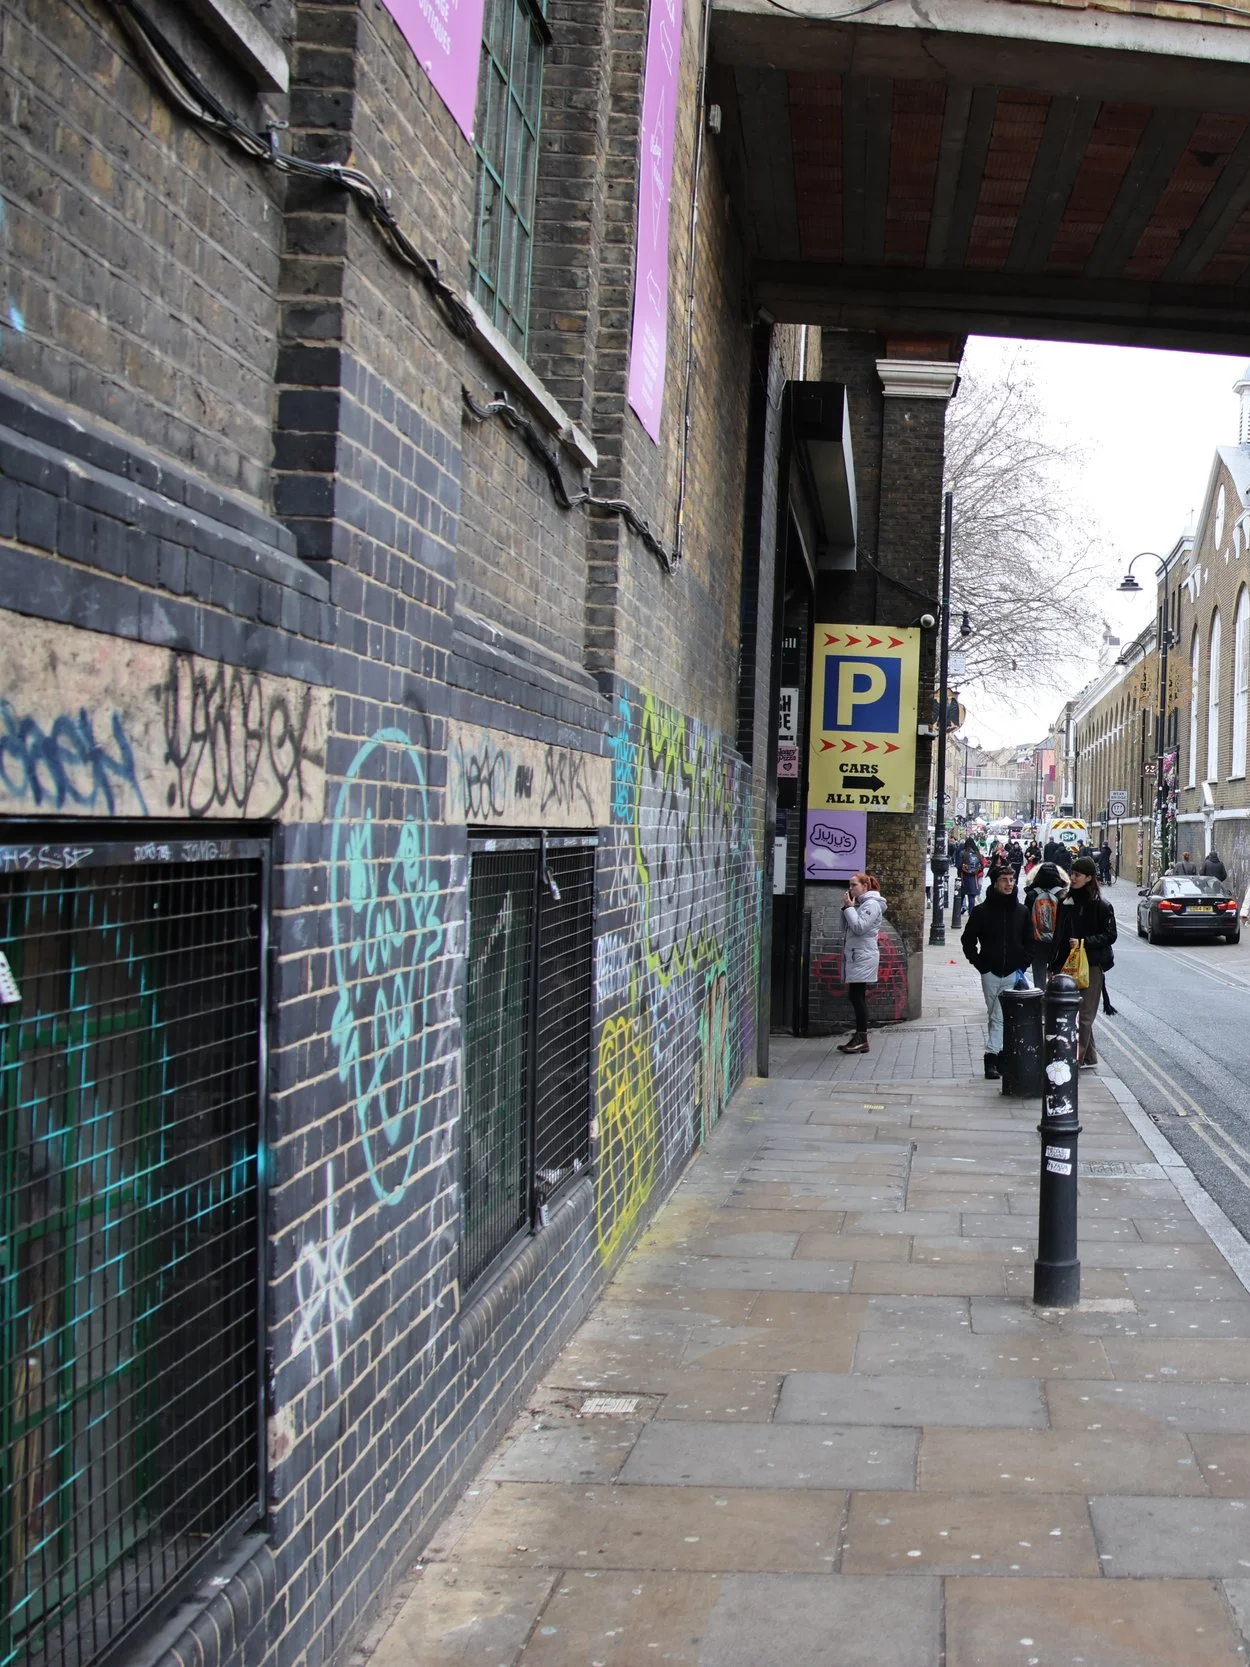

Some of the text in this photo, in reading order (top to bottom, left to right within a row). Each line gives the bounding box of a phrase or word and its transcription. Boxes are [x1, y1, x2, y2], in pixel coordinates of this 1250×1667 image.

[837, 661, 887, 726] P
[839, 763, 879, 774] CARS
[826, 793, 891, 805] ALL DAY
